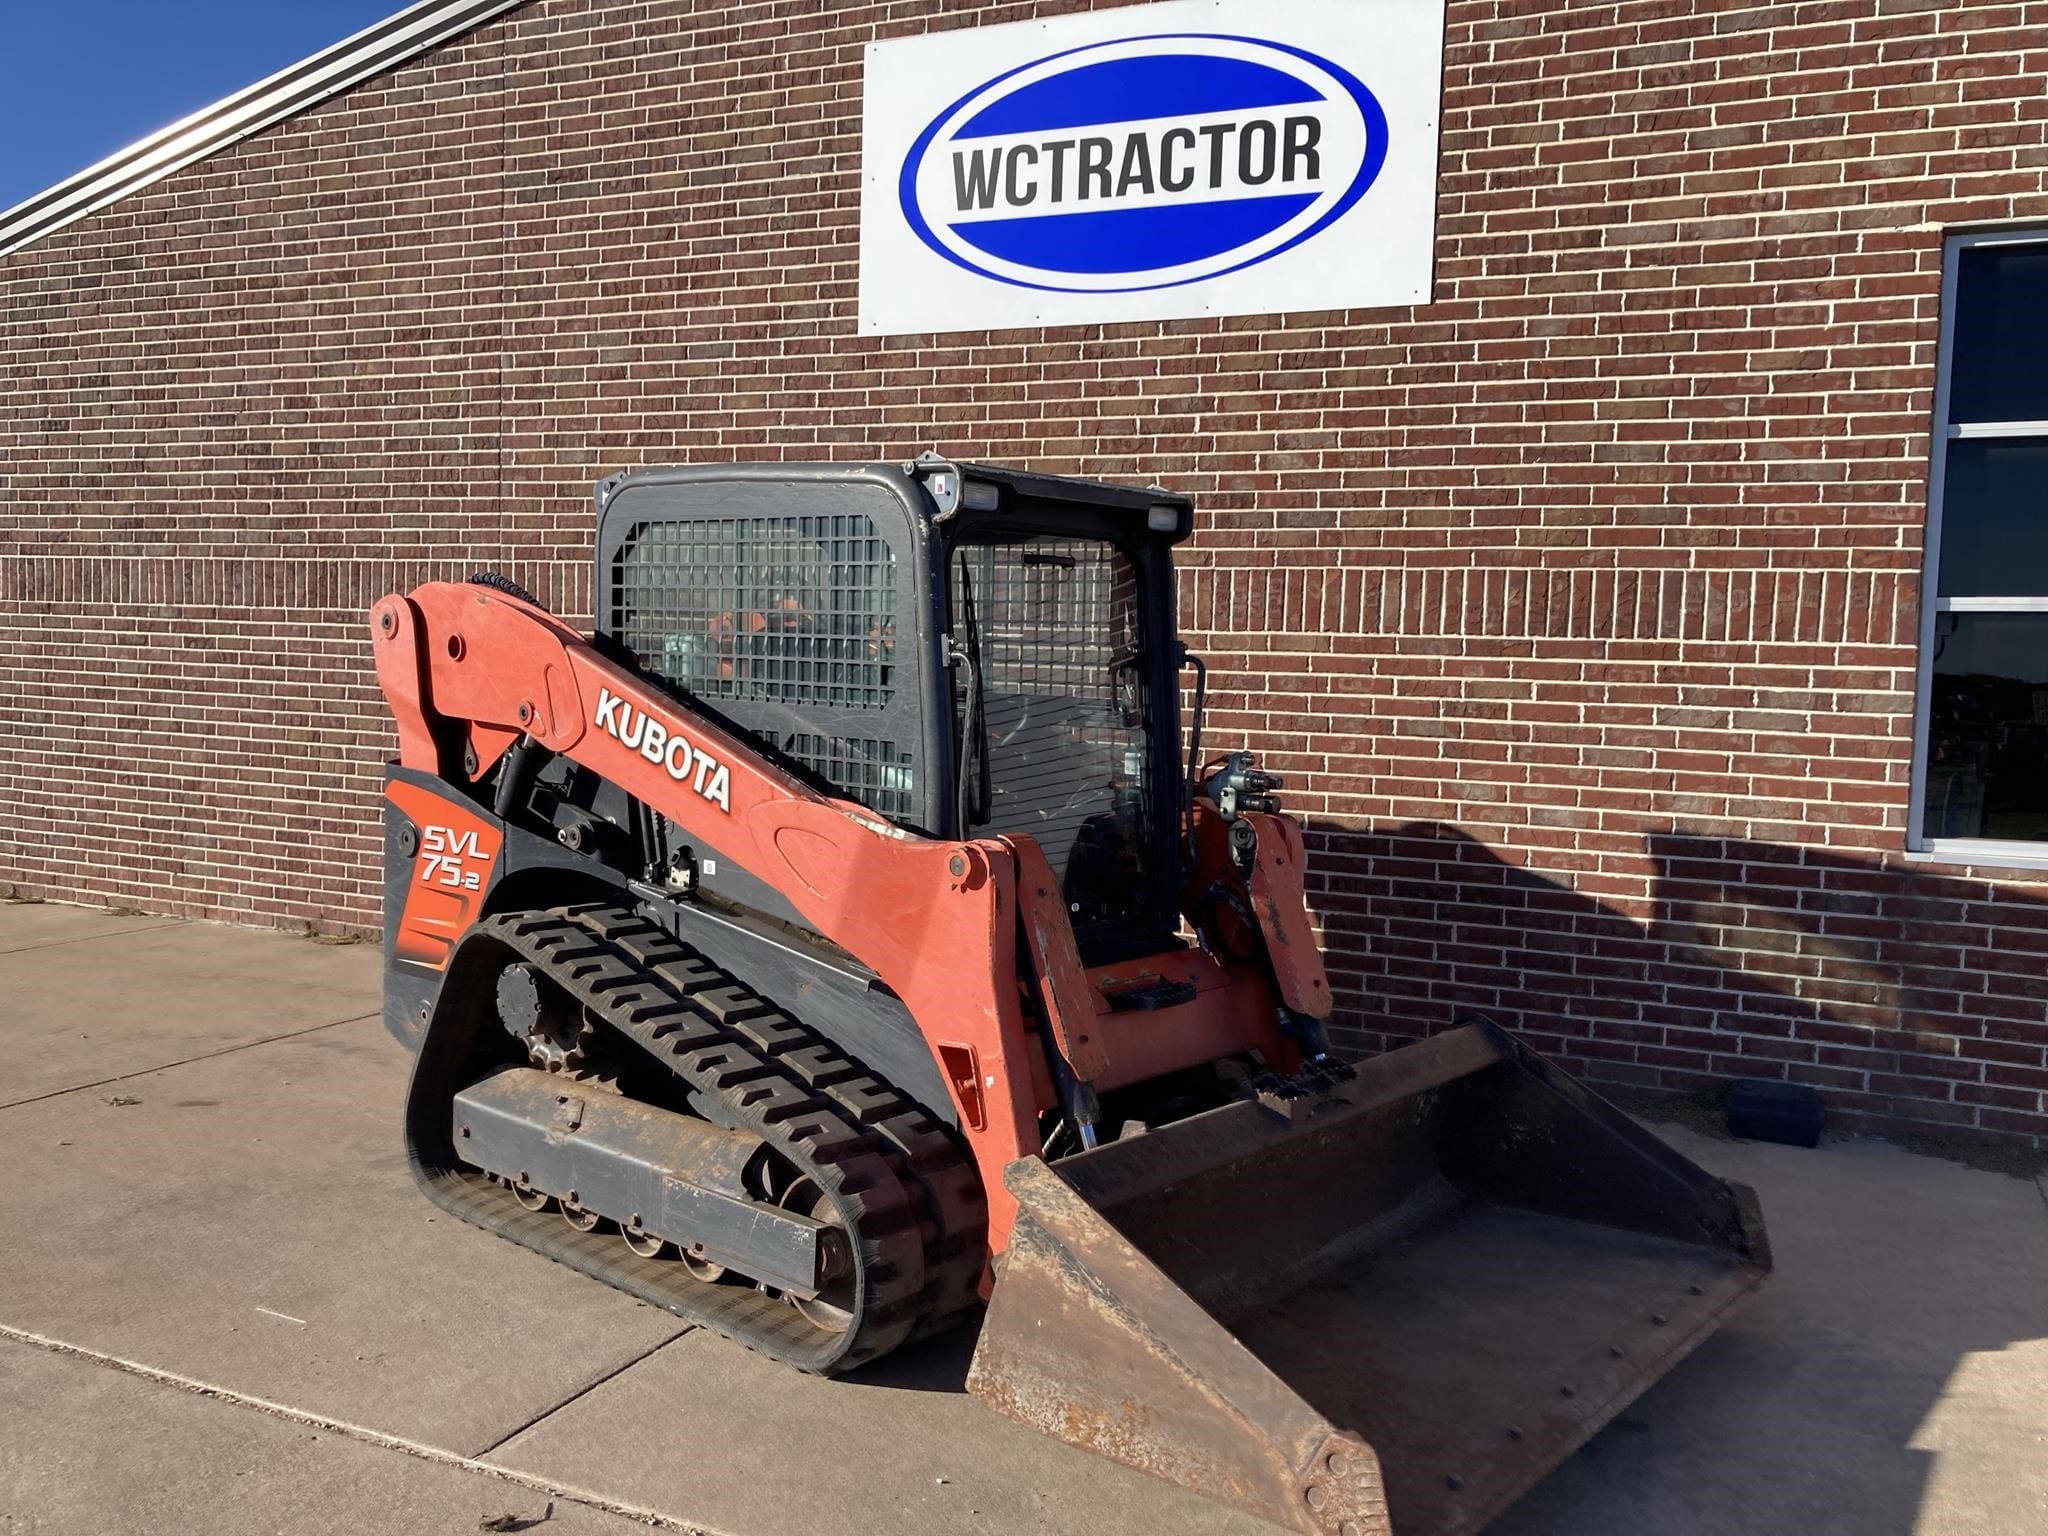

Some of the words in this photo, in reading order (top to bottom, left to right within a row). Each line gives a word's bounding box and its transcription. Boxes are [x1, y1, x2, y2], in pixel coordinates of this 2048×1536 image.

[952, 115, 1321, 211] WCTRACTOR
[595, 687, 730, 814] KUBOTA
[422, 825, 490, 860] SVL
